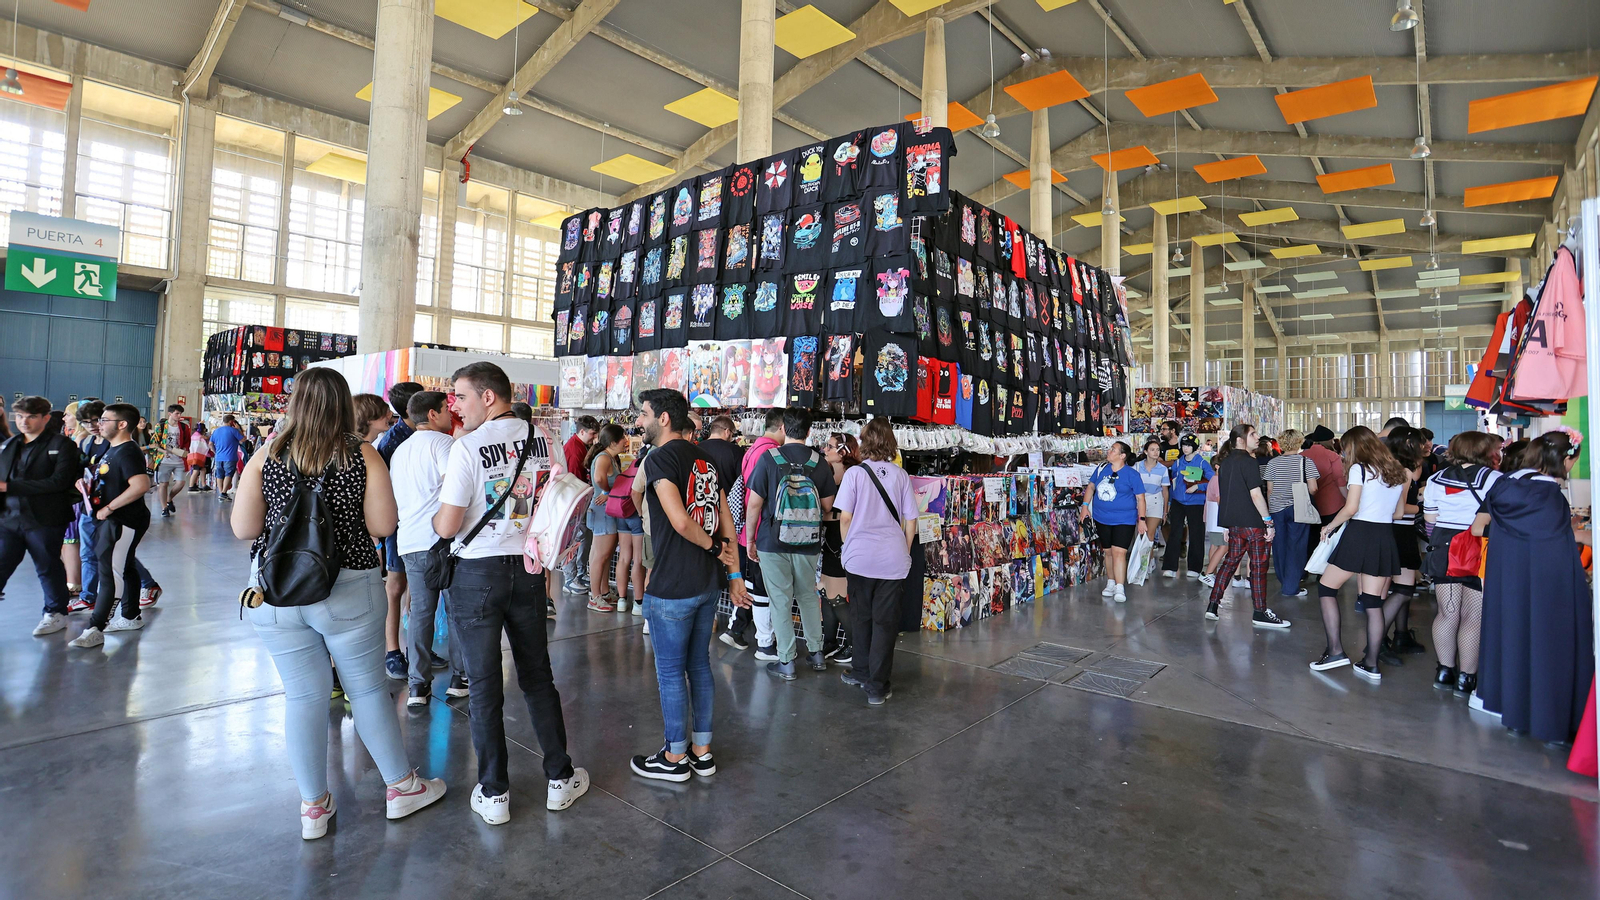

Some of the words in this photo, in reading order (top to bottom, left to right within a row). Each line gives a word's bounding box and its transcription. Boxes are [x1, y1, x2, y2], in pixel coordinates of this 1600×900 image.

[906, 142, 941, 155] MAKIMA
[27, 227, 84, 245] PUERTA
[94, 238, 104, 248] 4
[797, 273, 818, 281] SMILE
[560, 358, 582, 367] WANTED
[479, 443, 508, 469] SPY
[493, 796, 508, 805] FILA
